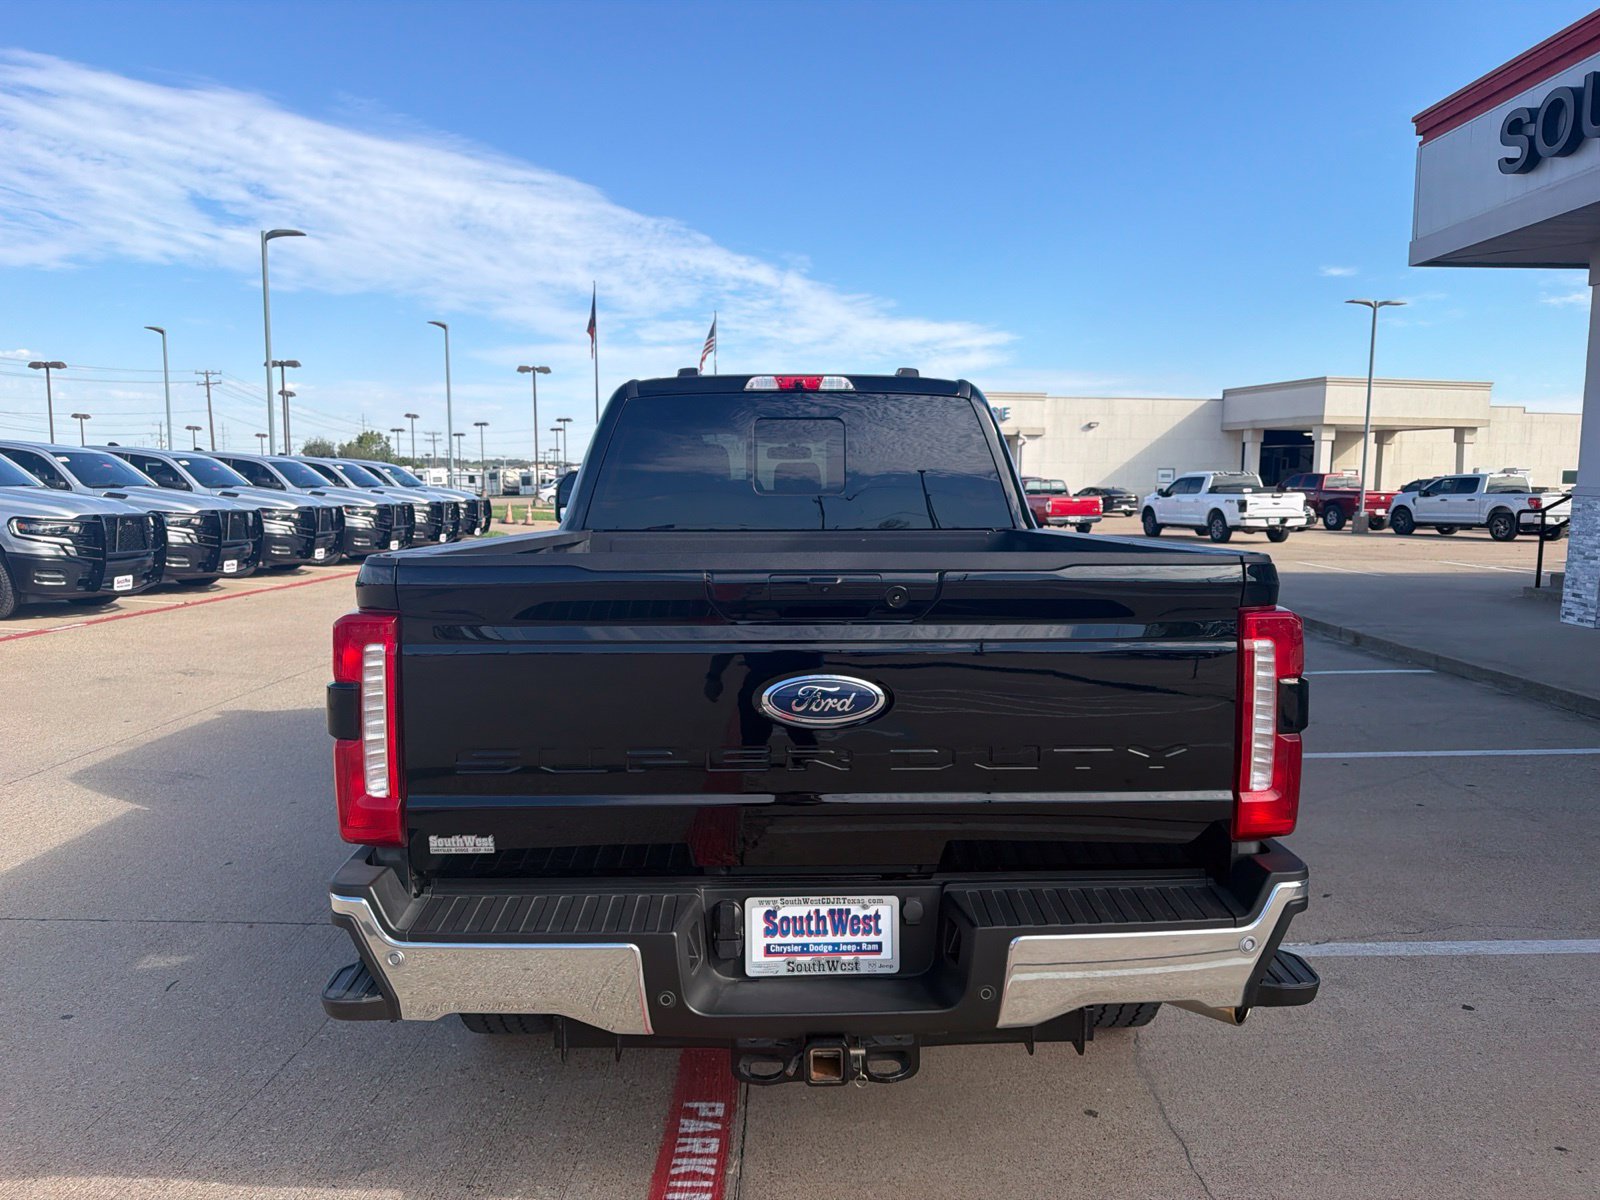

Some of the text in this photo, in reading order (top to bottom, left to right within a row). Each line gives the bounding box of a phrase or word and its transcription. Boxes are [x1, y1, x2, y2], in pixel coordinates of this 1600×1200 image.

[791, 685, 857, 712] Ford
[455, 743, 1188, 774] SUPER DUTY
[428, 834, 494, 847] SouthWest
[763, 908, 882, 939] SouthWest
[770, 943, 879, 954] Chrysler Dodge Jeep Ram
[787, 960, 859, 972] SouthWest
